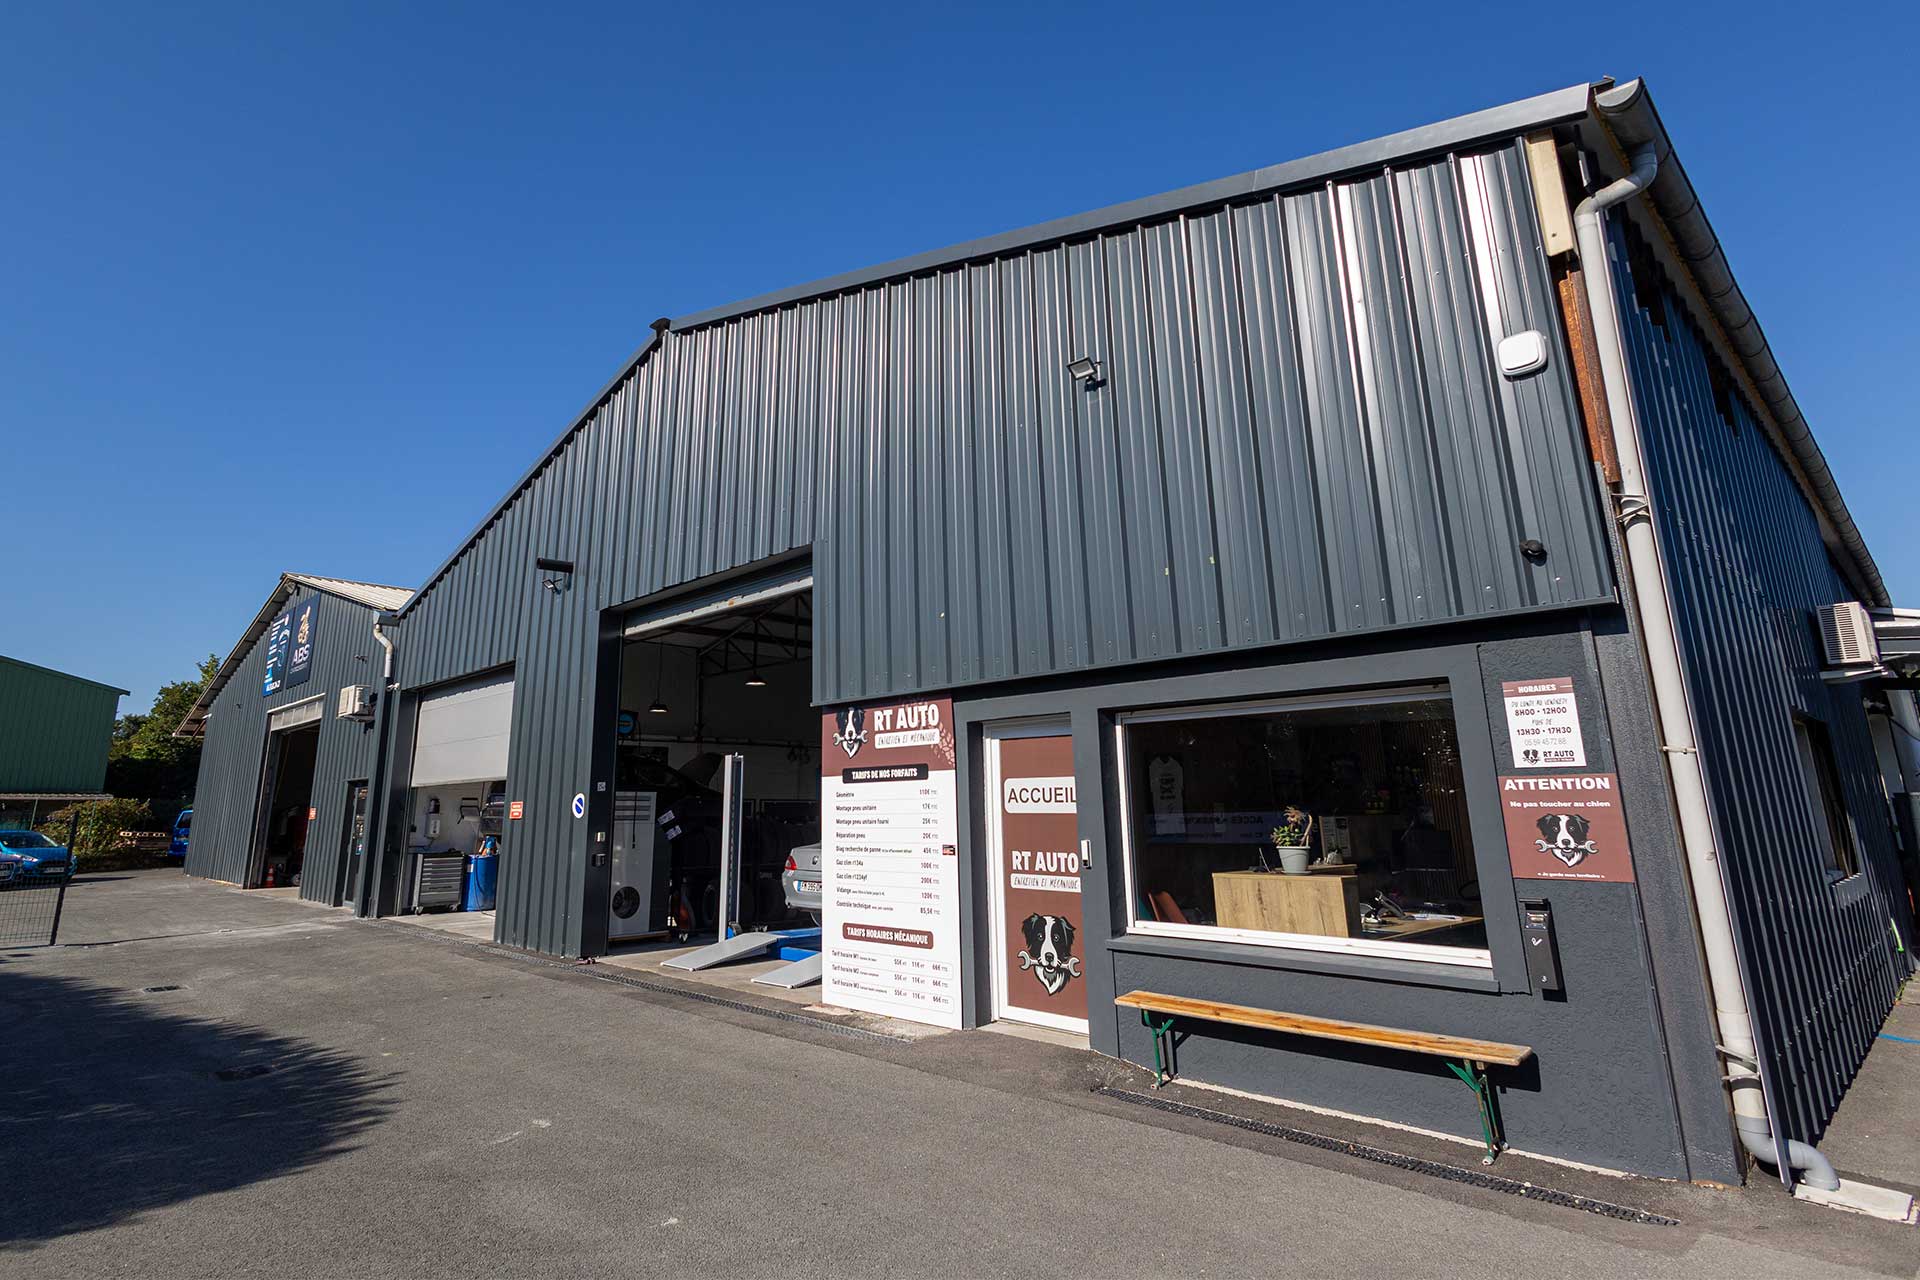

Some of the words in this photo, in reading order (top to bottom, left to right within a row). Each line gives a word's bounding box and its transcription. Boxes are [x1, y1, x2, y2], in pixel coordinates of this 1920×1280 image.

[291, 644, 310, 666] ABS
[1518, 684, 1556, 693] HORAIRES
[1542, 706, 1567, 714] 12H00
[874, 709, 893, 731] RT
[896, 704, 939, 729] AUTO
[1517, 728, 1540, 736] 13H30
[1548, 726, 1572, 734] 17H30
[852, 771, 870, 780] TARIFS
[871, 770, 878, 779] DE
[879, 769, 890, 778] NOS
[891, 768, 918, 778] FORFAITS
[1504, 777, 1610, 790] ATTENTION
[1008, 787, 1076, 803] ACCUEIL
[1012, 850, 1031, 871] RT
[1035, 851, 1079, 873] AUTO
[1014, 877, 1039, 887] ENTRETIEN
[847, 927, 865, 937] TARIFS
[866, 929, 893, 940] HORAIRES
[894, 930, 928, 944] MÉCANIQUE
